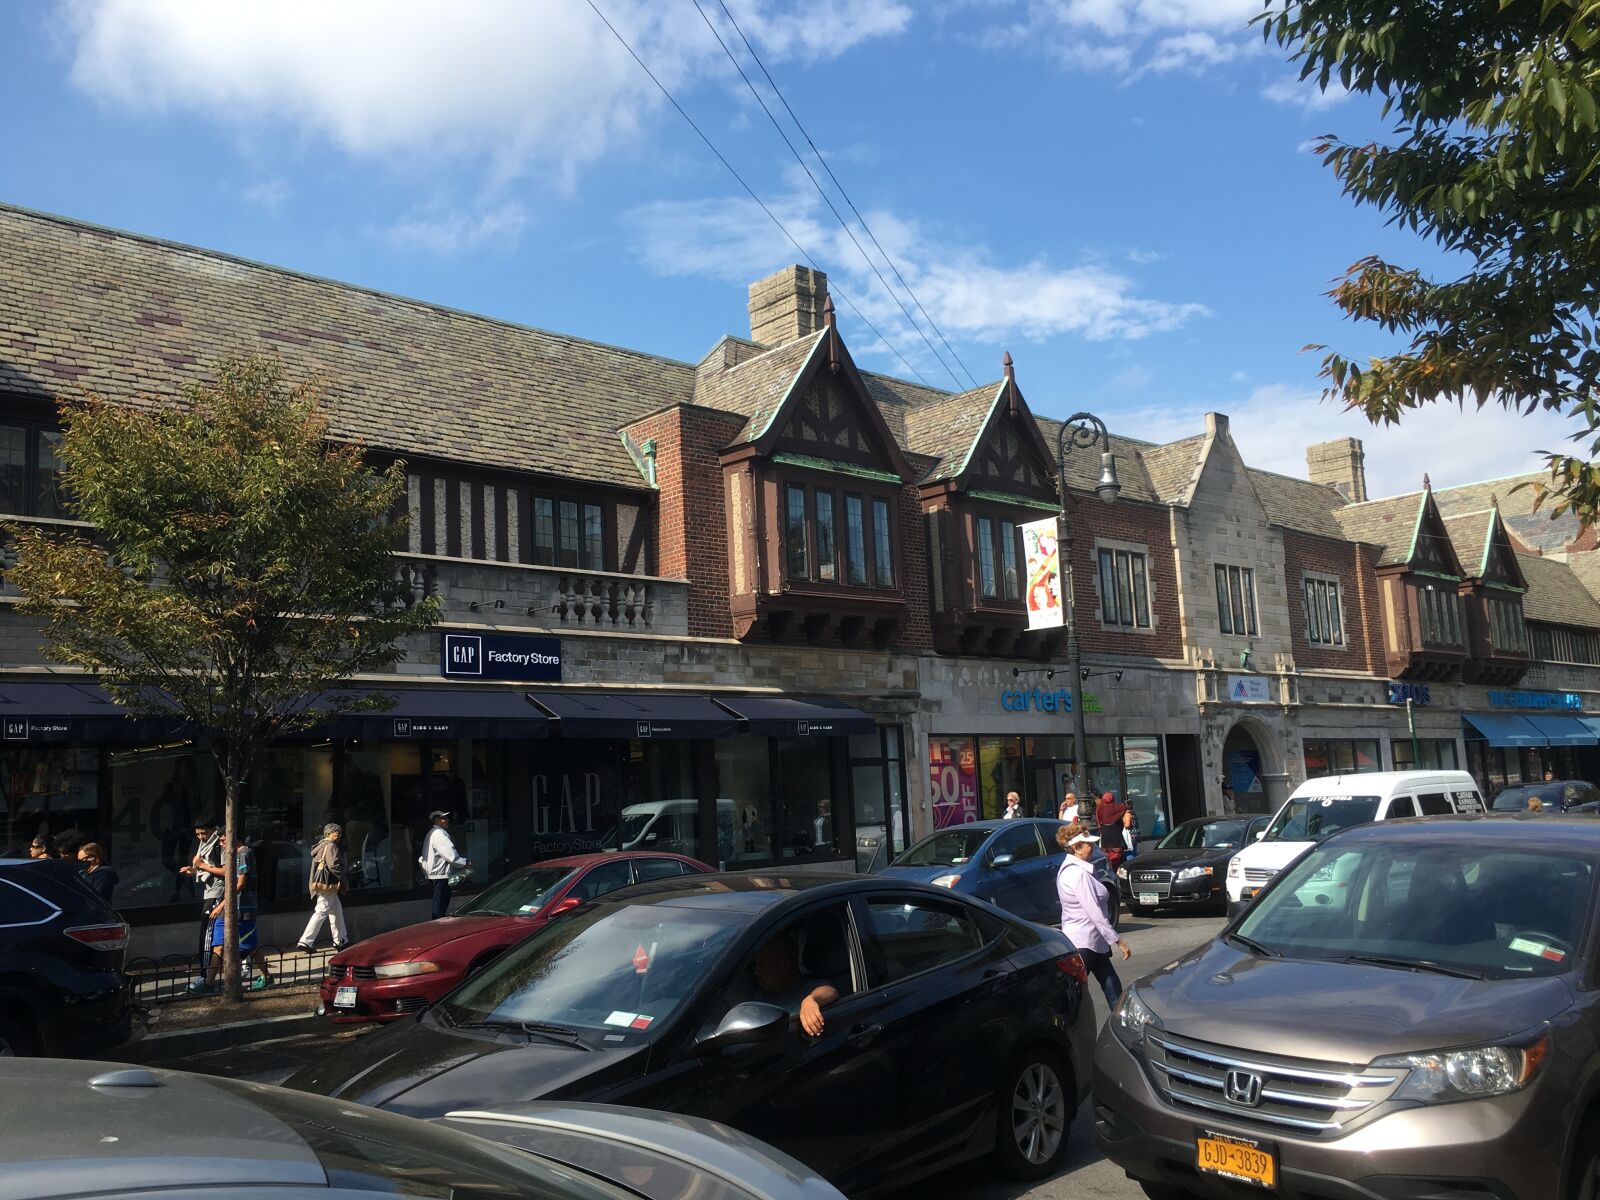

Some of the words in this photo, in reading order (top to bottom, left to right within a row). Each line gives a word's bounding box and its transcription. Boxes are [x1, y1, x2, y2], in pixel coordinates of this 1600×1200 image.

[453, 645, 475, 664] GAP
[488, 650, 530, 666] Factory
[530, 652, 560, 665] Store
[8, 723, 23, 734] GAP
[532, 773, 601, 836] GAP
[961, 783, 977, 823] OFF
[1217, 1170, 1252, 1183] PARAGON
